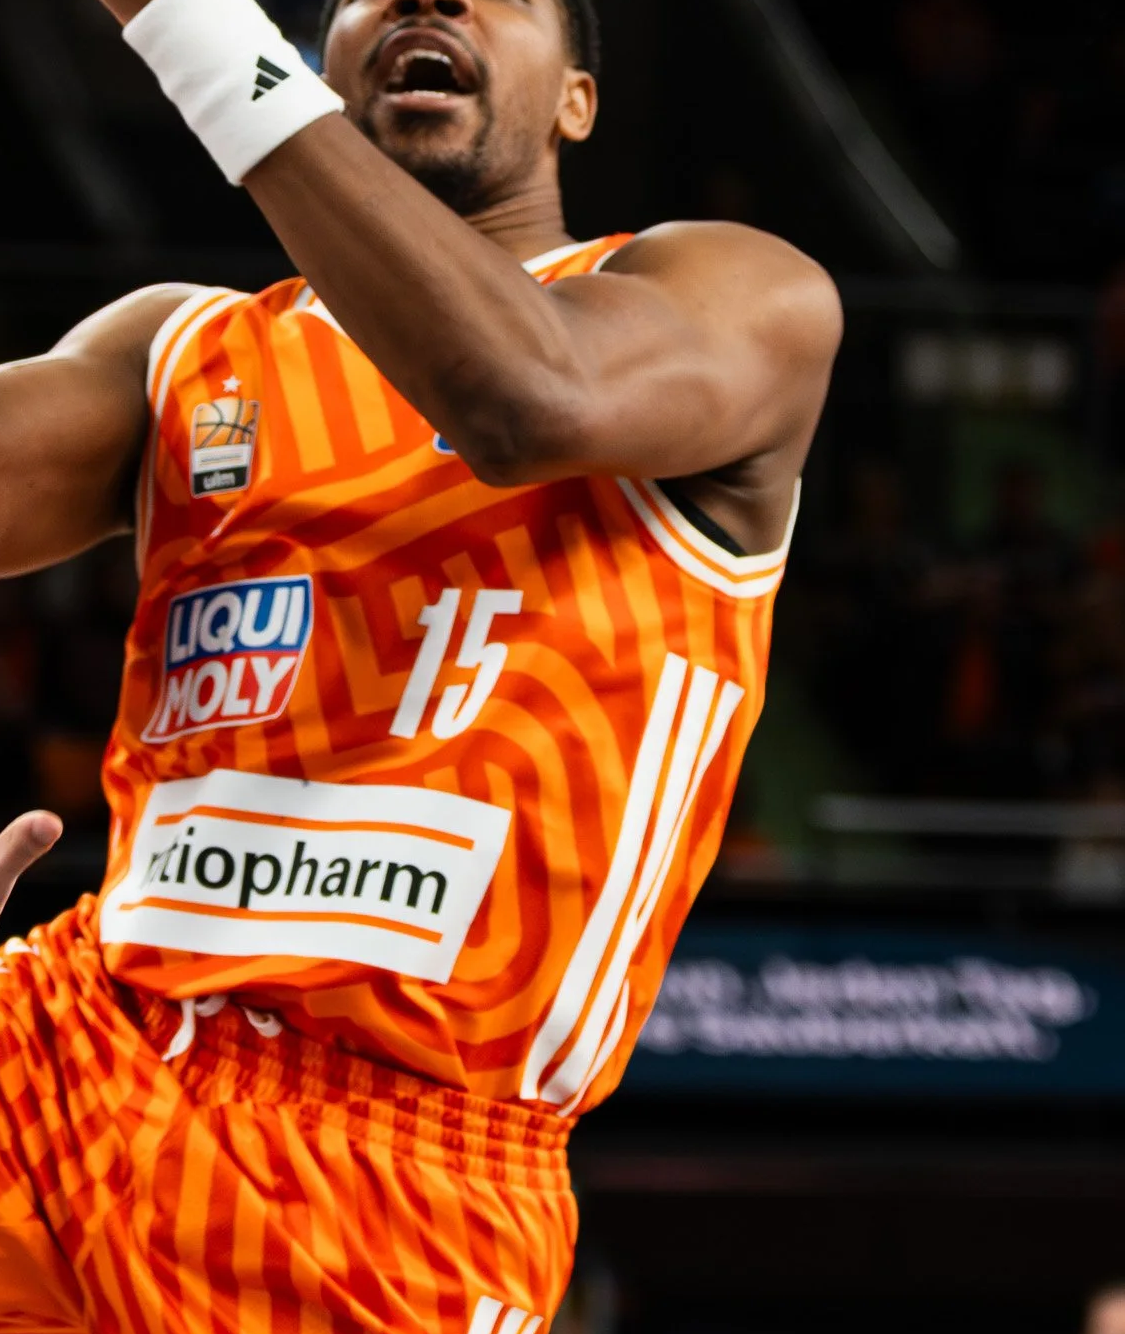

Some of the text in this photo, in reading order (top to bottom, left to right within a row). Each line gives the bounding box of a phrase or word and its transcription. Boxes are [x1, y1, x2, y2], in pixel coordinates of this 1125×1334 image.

[171, 585, 306, 653] LIQUI
[157, 656, 297, 735] MOLY
[389, 587, 525, 741] 15
